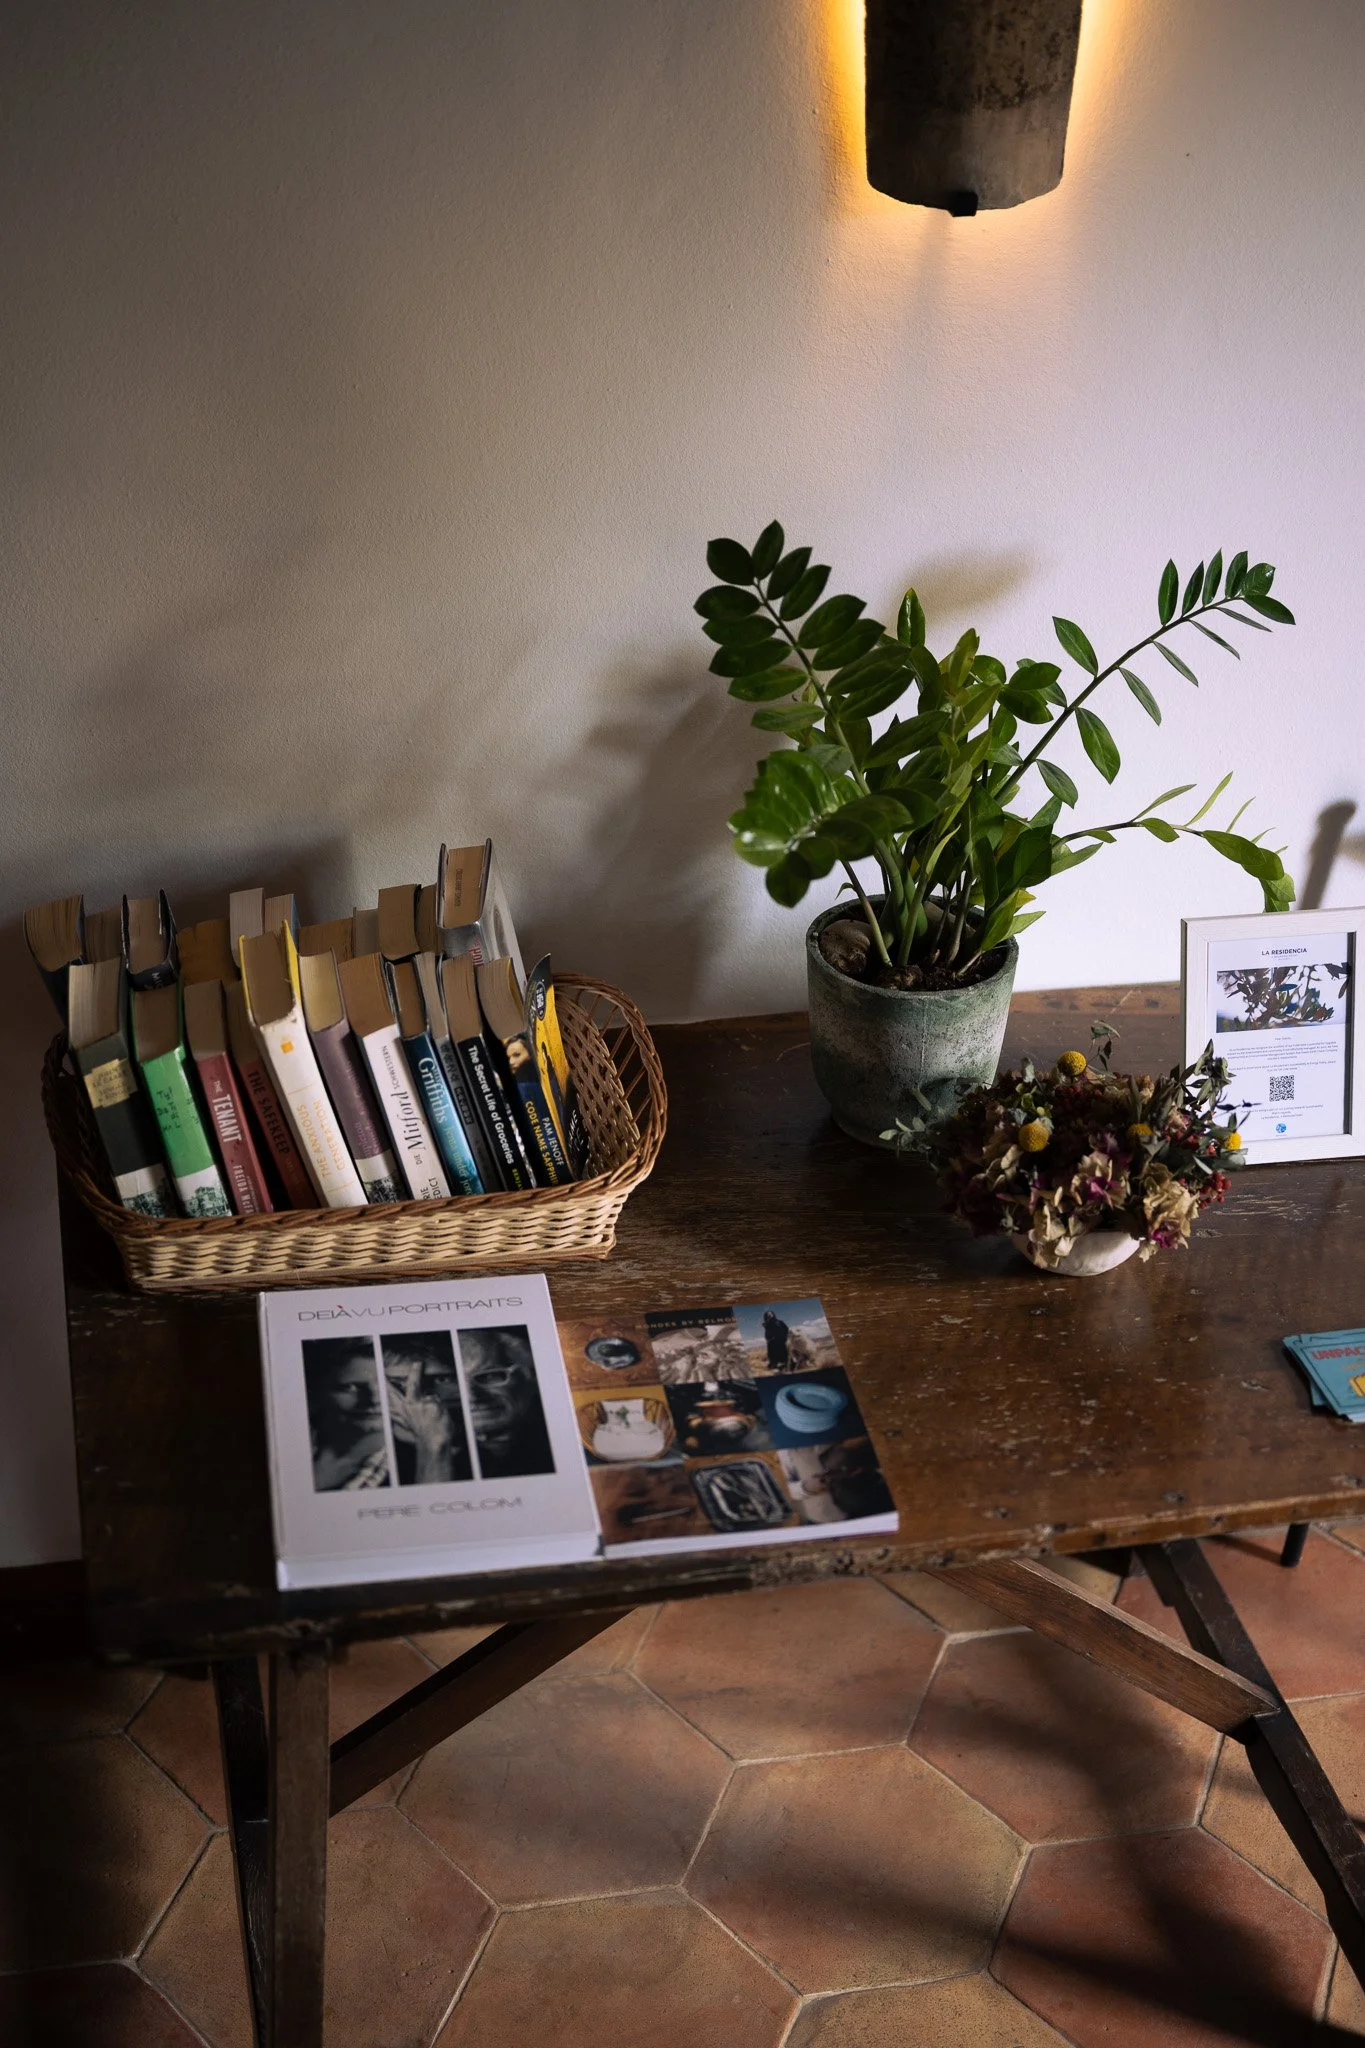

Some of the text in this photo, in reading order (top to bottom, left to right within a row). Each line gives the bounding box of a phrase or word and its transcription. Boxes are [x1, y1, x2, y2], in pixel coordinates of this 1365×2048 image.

[1271, 947, 1307, 955] RESIDENCIA
[246, 1069, 289, 1155] THE SAFEKEEP
[417, 1056, 449, 1123] Griffiths
[466, 1044, 516, 1164] The Secret Life of Groceries
[211, 1093, 242, 1144] TENANT
[297, 1104, 321, 1154] ANXIOUS
[314, 1099, 344, 1170] GENERATION
[390, 1088, 425, 1152] Mitford
[523, 1100, 539, 1124] CODE
[532, 1124, 548, 1151] NAME
[541, 1116, 564, 1166] PAM JENOFF
[232, 1163, 248, 1193] FREIDA
[316, 1156, 331, 1178] THE
[413, 1153, 422, 1165] DIE
[453, 1151, 468, 1177] under
[239, 1193, 254, 1215] McFA
[388, 1296, 522, 1315] PORTRAITS
[356, 1494, 521, 1521] PERE COLOM
